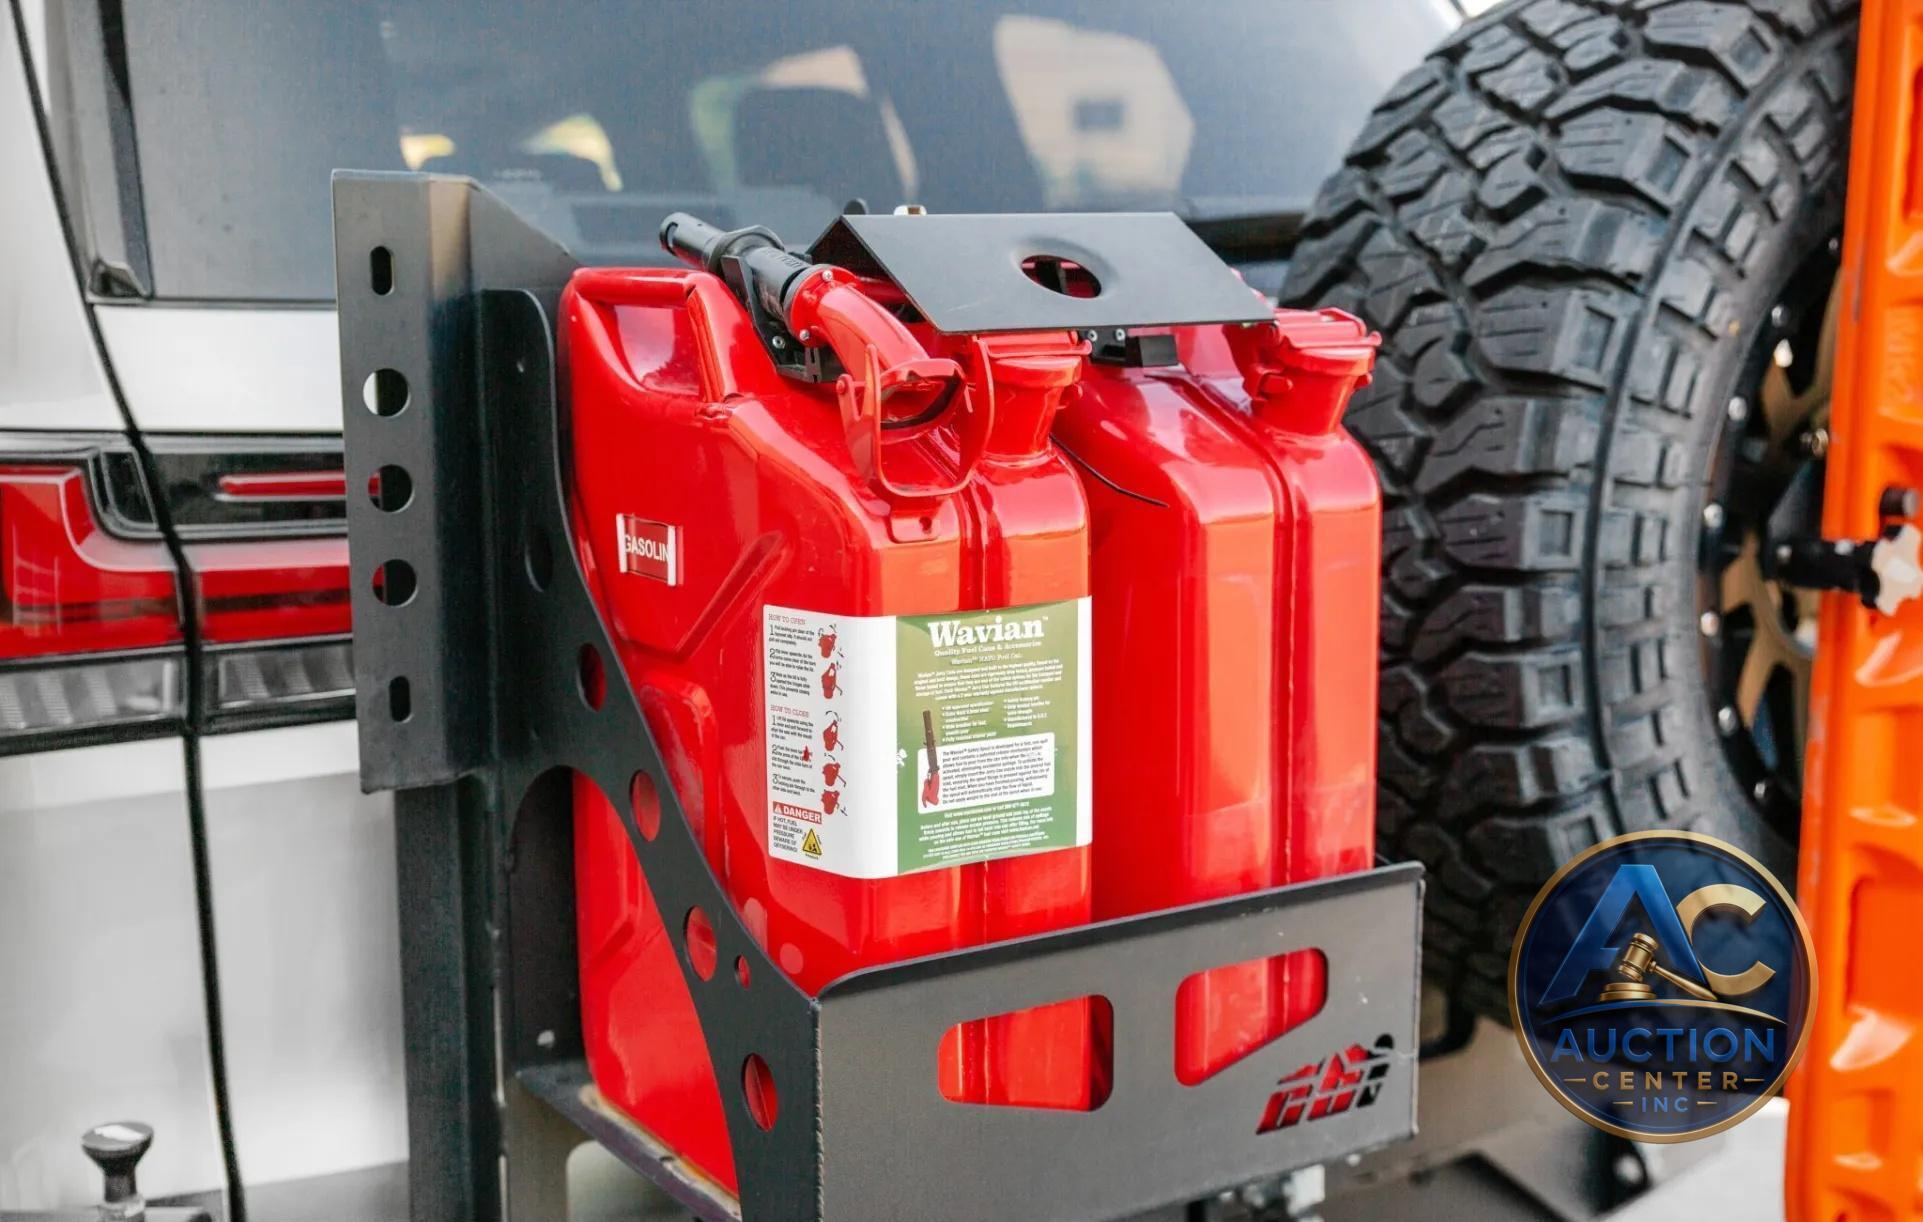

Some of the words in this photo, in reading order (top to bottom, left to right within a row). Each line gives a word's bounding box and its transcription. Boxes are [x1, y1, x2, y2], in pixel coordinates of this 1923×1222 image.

[934, 647, 960, 657] Quality
[961, 646, 978, 655] Fuel
[783, 805, 820, 823] DANGER
